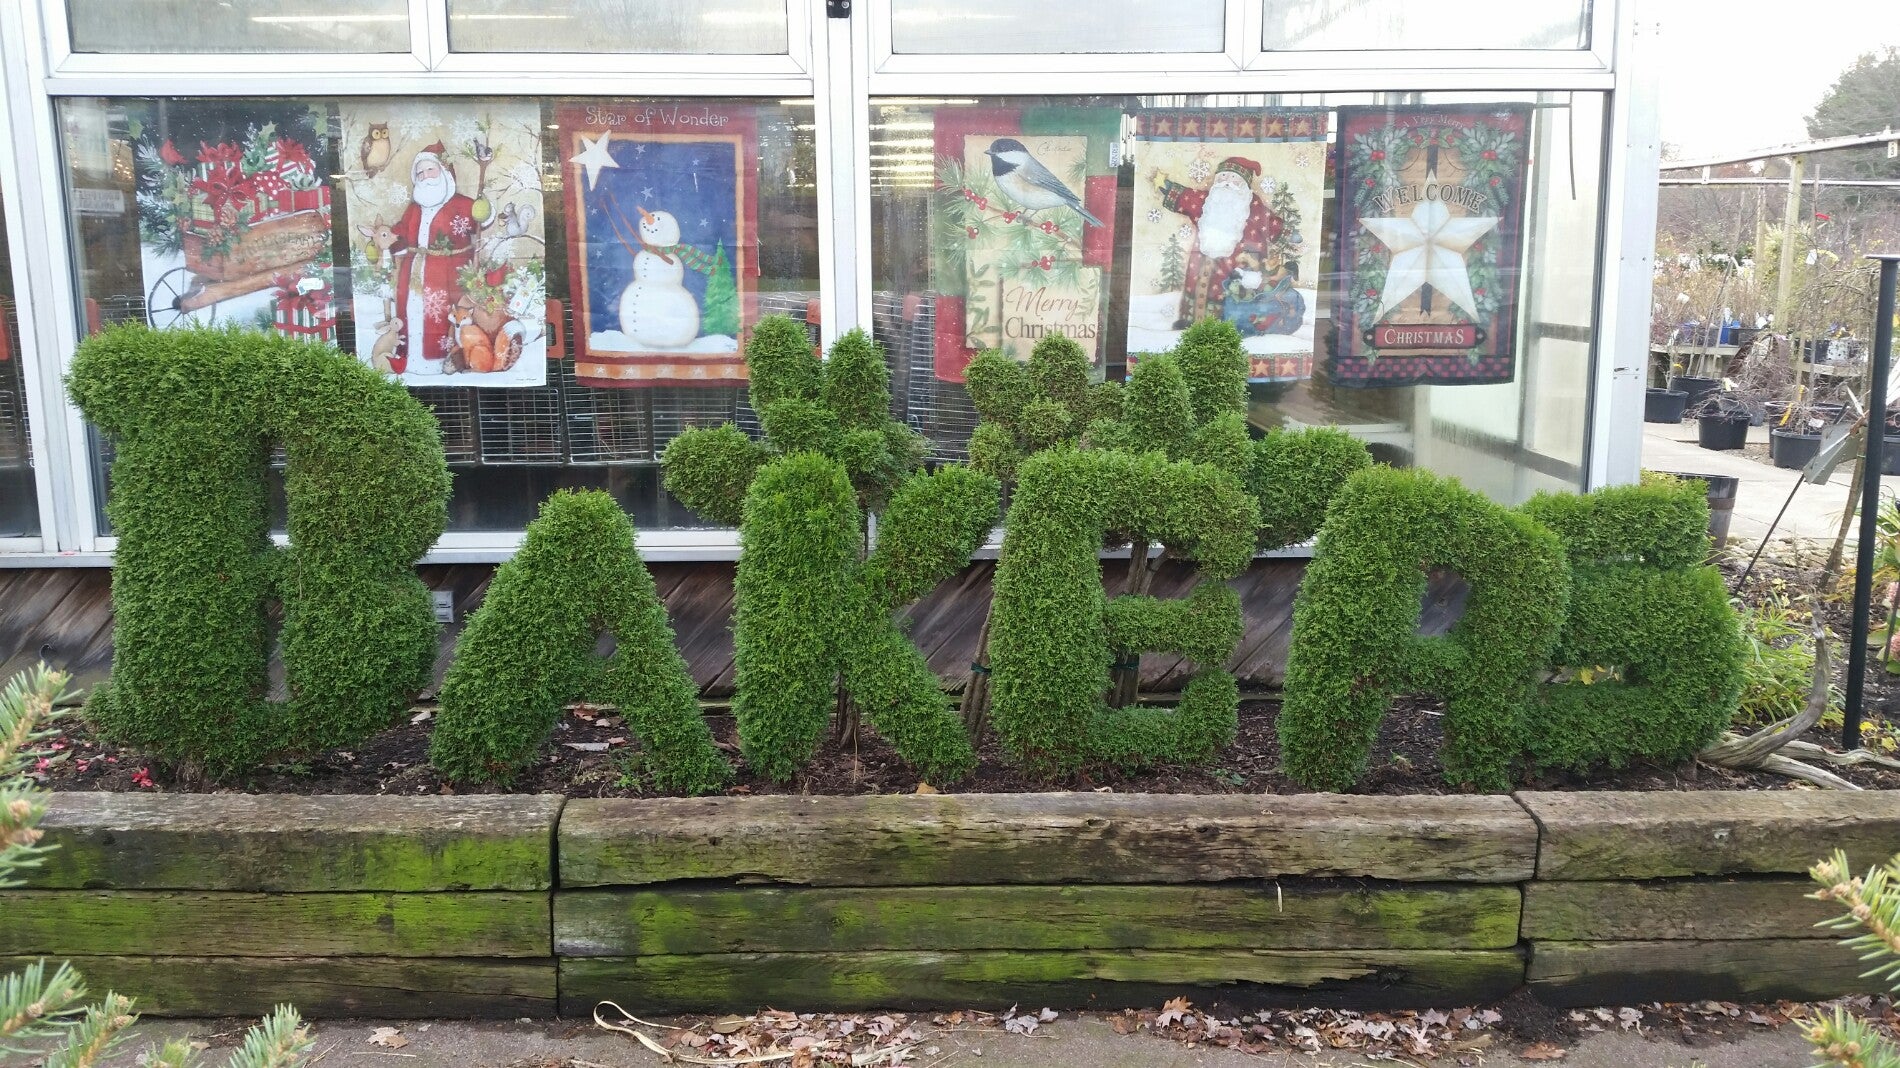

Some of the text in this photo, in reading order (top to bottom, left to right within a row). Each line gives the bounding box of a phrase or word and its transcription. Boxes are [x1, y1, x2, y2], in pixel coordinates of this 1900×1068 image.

[585, 105, 729, 127] Star of Wonder
[1372, 183, 1488, 214] WELCOME
[1005, 286, 1080, 322] Merry
[1004, 316, 1097, 340] Christmas
[1384, 327, 1465, 346] CHRISTMAS
